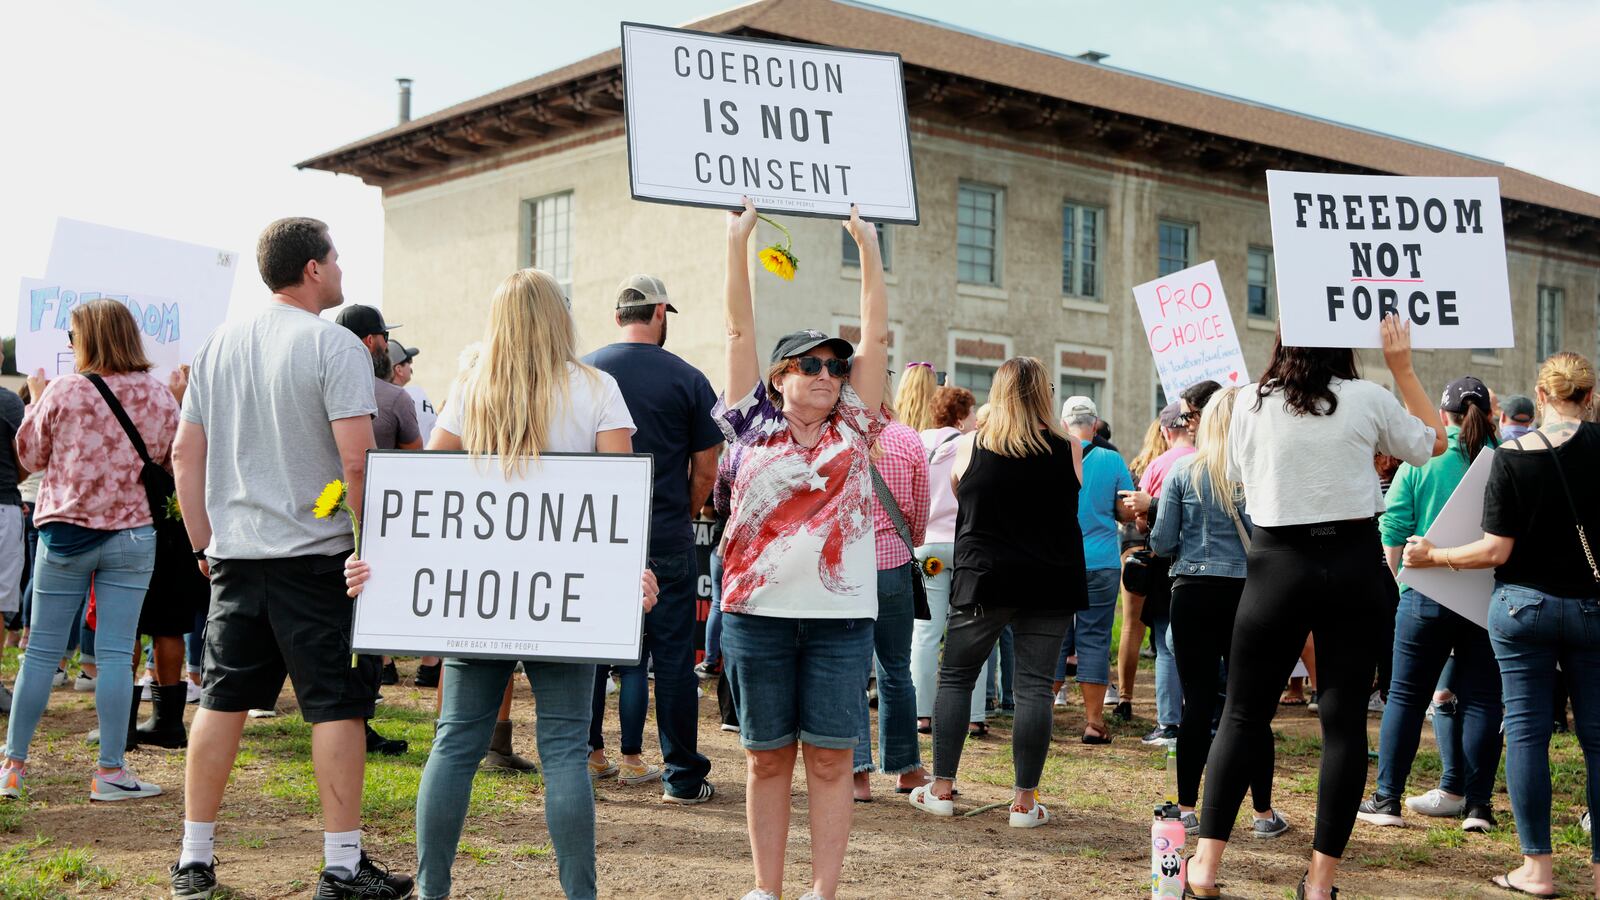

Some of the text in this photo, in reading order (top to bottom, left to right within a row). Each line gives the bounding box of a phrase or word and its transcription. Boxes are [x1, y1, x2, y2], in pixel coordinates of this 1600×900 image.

[674, 46, 843, 93] COERCION
[703, 98, 833, 144] IS NOT
[694, 152, 851, 196] CONSENT
[1294, 192, 1483, 234] FREEDOM
[1350, 242, 1422, 278] NOT
[1156, 282, 1213, 318] PRO
[1326, 285, 1460, 326] FORCE
[1150, 315, 1224, 353] CHOICE
[380, 489, 629, 544] PERSONAL
[1311, 526, 1336, 535] PINK
[412, 568, 585, 622] CHOICE
[447, 640, 469, 648] POWER
[470, 641, 487, 649] BACK
[515, 643, 539, 651] PEOPLE
